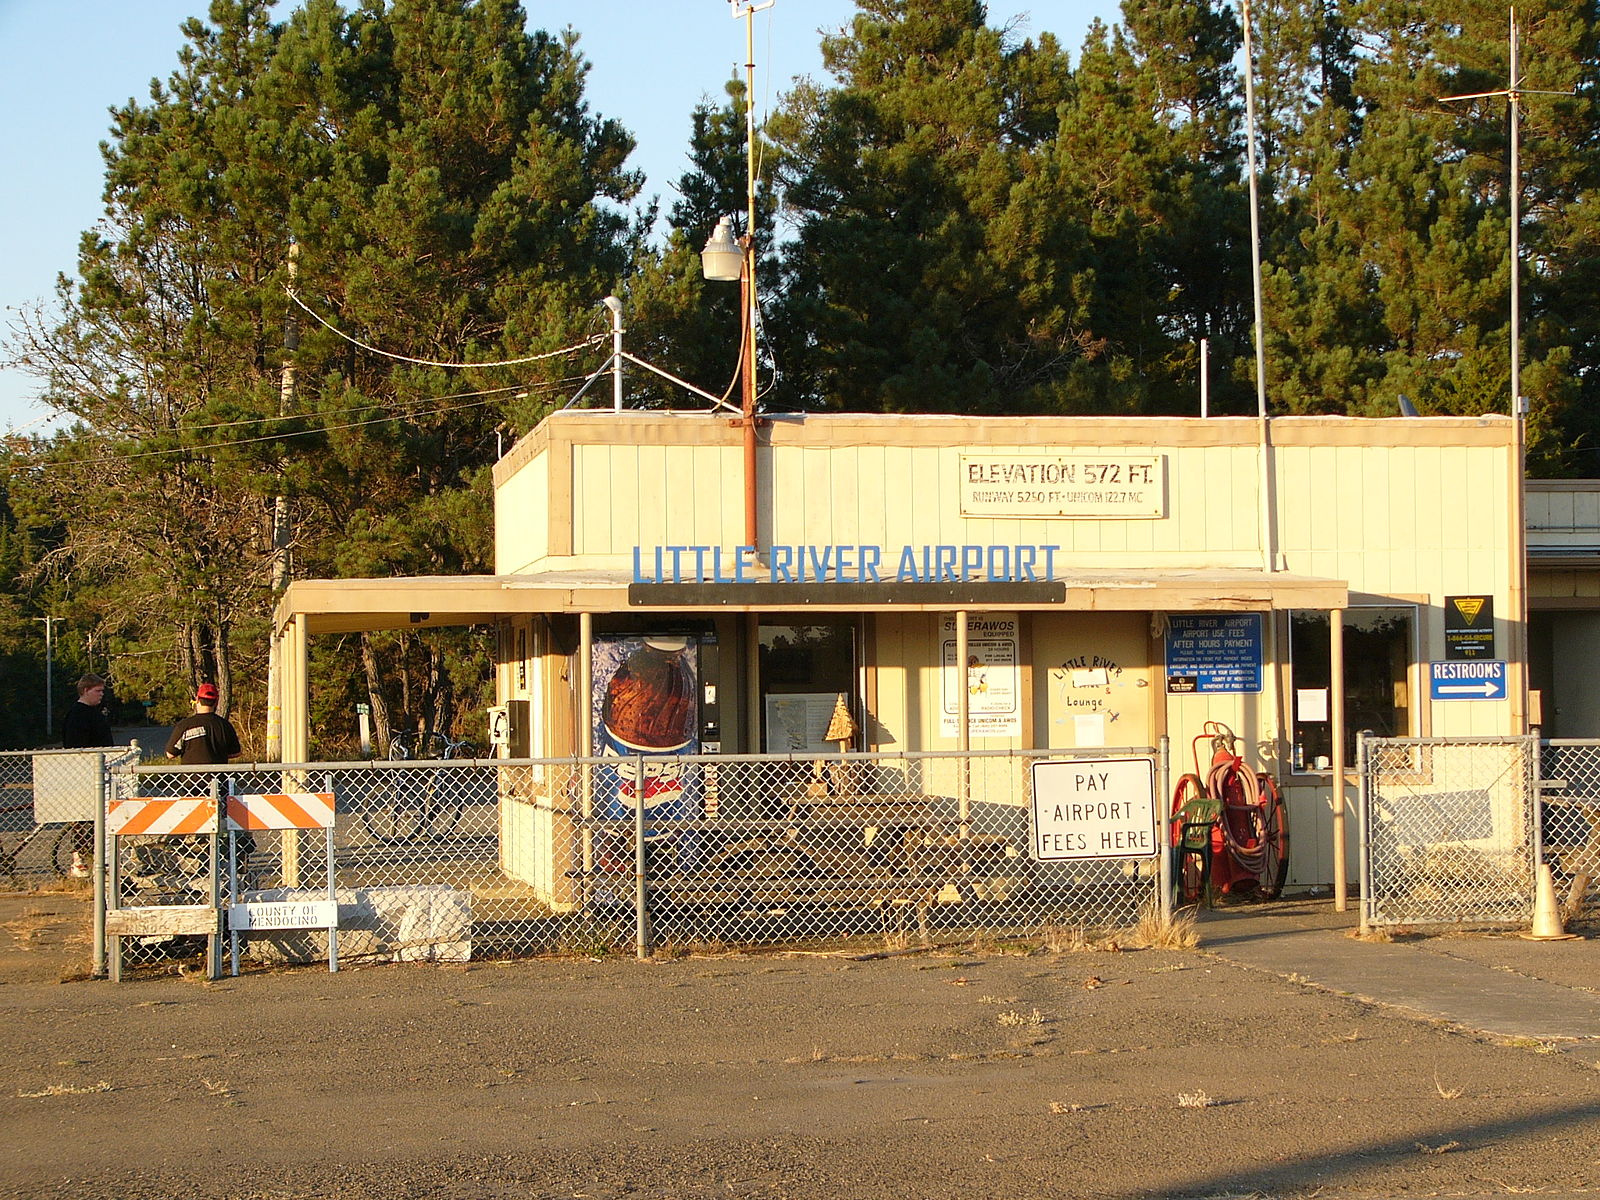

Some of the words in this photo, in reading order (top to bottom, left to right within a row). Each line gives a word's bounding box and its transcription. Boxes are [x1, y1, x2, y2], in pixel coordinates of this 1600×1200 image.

[968, 464, 1075, 484] ELEVATION
[1084, 464, 1121, 484] 572
[1129, 465, 1153, 484] FT.
[973, 491, 1014, 503] RUNWAY
[633, 546, 756, 584] LITTLE
[770, 545, 882, 584] RIVER
[896, 545, 1060, 583] AIRPORT
[944, 621, 1014, 631] SUERAWOS
[1172, 619, 1194, 628] LITTLE
[1199, 619, 1218, 627] RIVER
[1224, 618, 1253, 627] AIRPORT
[1182, 629, 1208, 638] AIRPORT
[1212, 629, 1225, 638] USE
[1228, 629, 1245, 637] FEES
[1173, 640, 1194, 649] AFTER
[1199, 640, 1220, 648] HOURS
[1224, 639, 1253, 648] PAYMENT
[1434, 663, 1501, 679] RESTROOMS
[1067, 696, 1103, 711] Lounge
[1075, 773, 1109, 791] PAY
[1053, 802, 1132, 822] AIRPORT
[1042, 833, 1087, 852] FEES
[1101, 831, 1149, 849] HERE
[248, 906, 296, 917] COUNTY
[301, 905, 318, 916] OF
[249, 915, 318, 927] MENDOCINO
